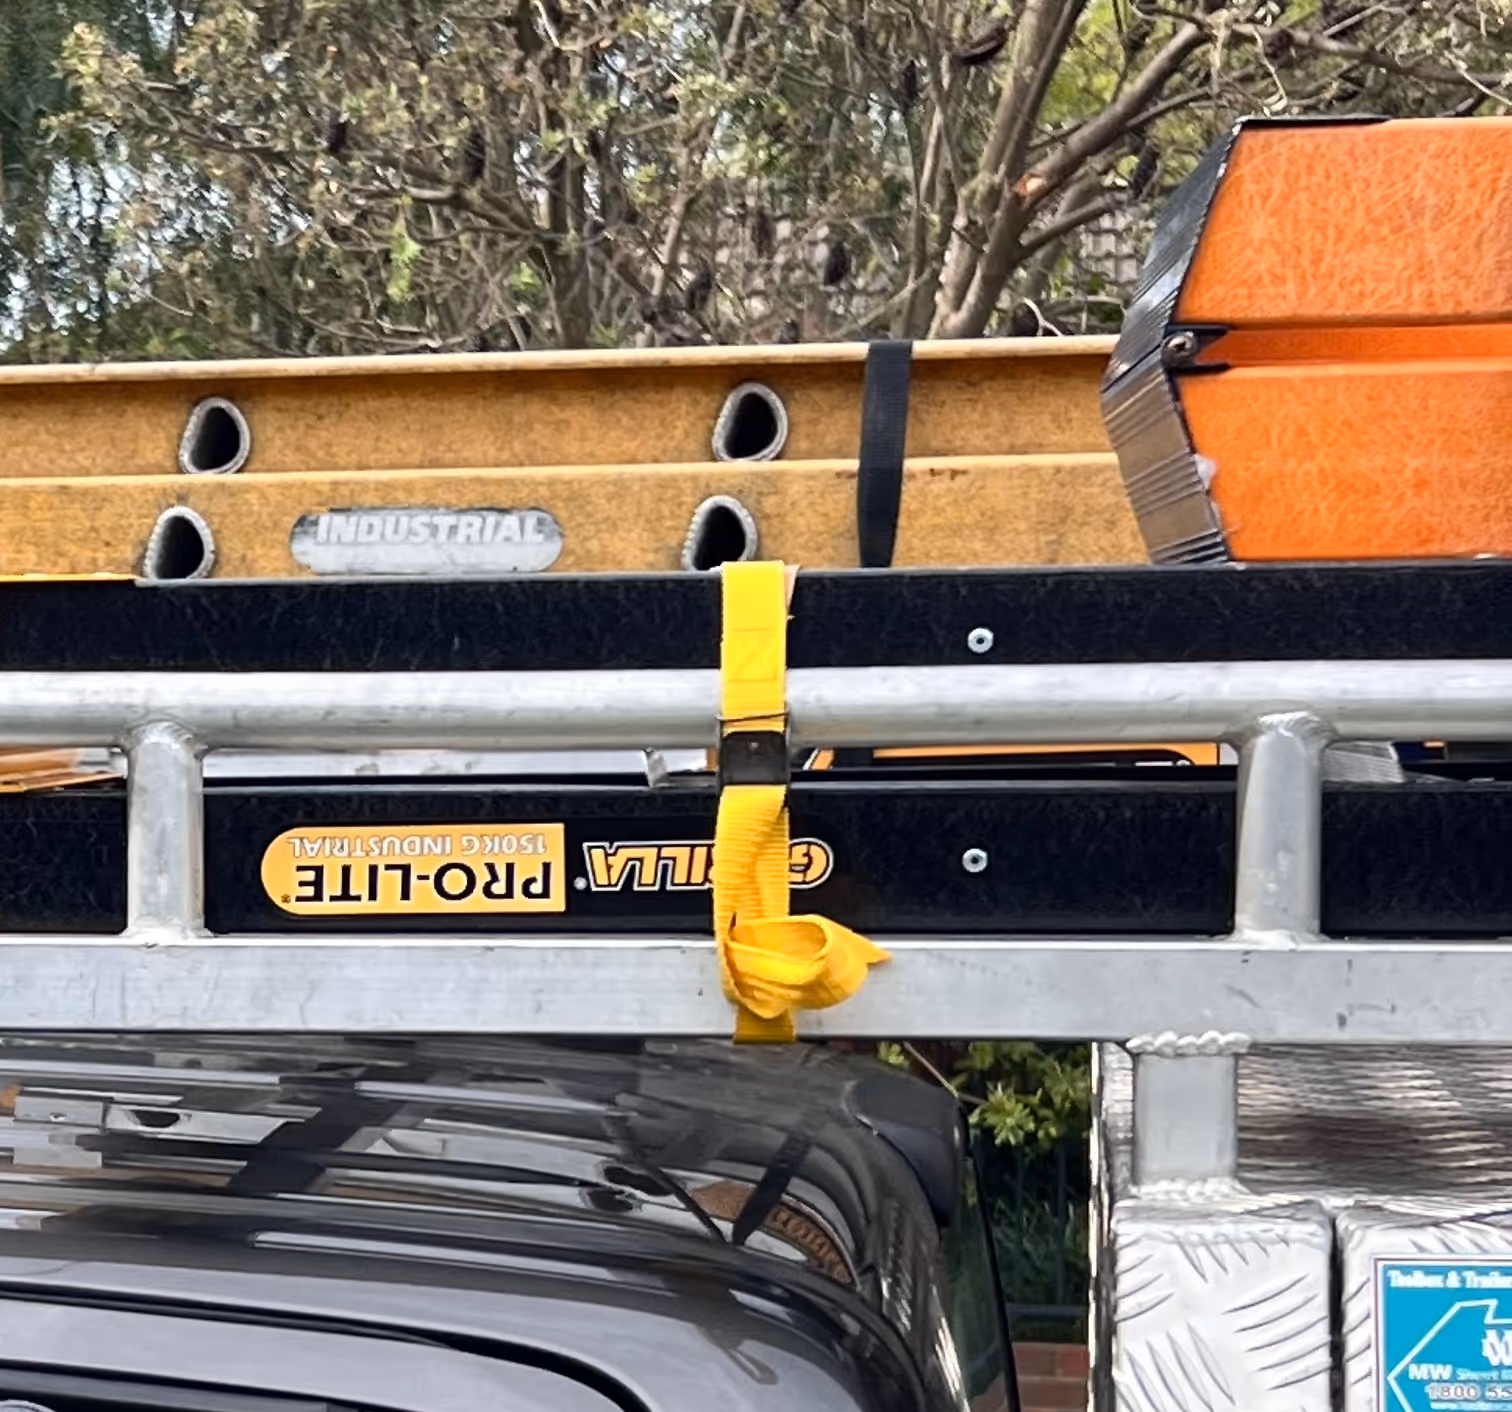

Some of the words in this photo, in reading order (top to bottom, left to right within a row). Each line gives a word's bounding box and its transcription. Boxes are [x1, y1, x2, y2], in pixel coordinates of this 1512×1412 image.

[315, 514, 548, 544] INDUSTRIAL
[287, 835, 452, 857] INDUSTRIAL
[461, 833, 547, 855] 150KG
[583, 837, 834, 892] GILLA
[294, 862, 552, 903] PRO-LITE
[1408, 1364, 1452, 1380] MW
